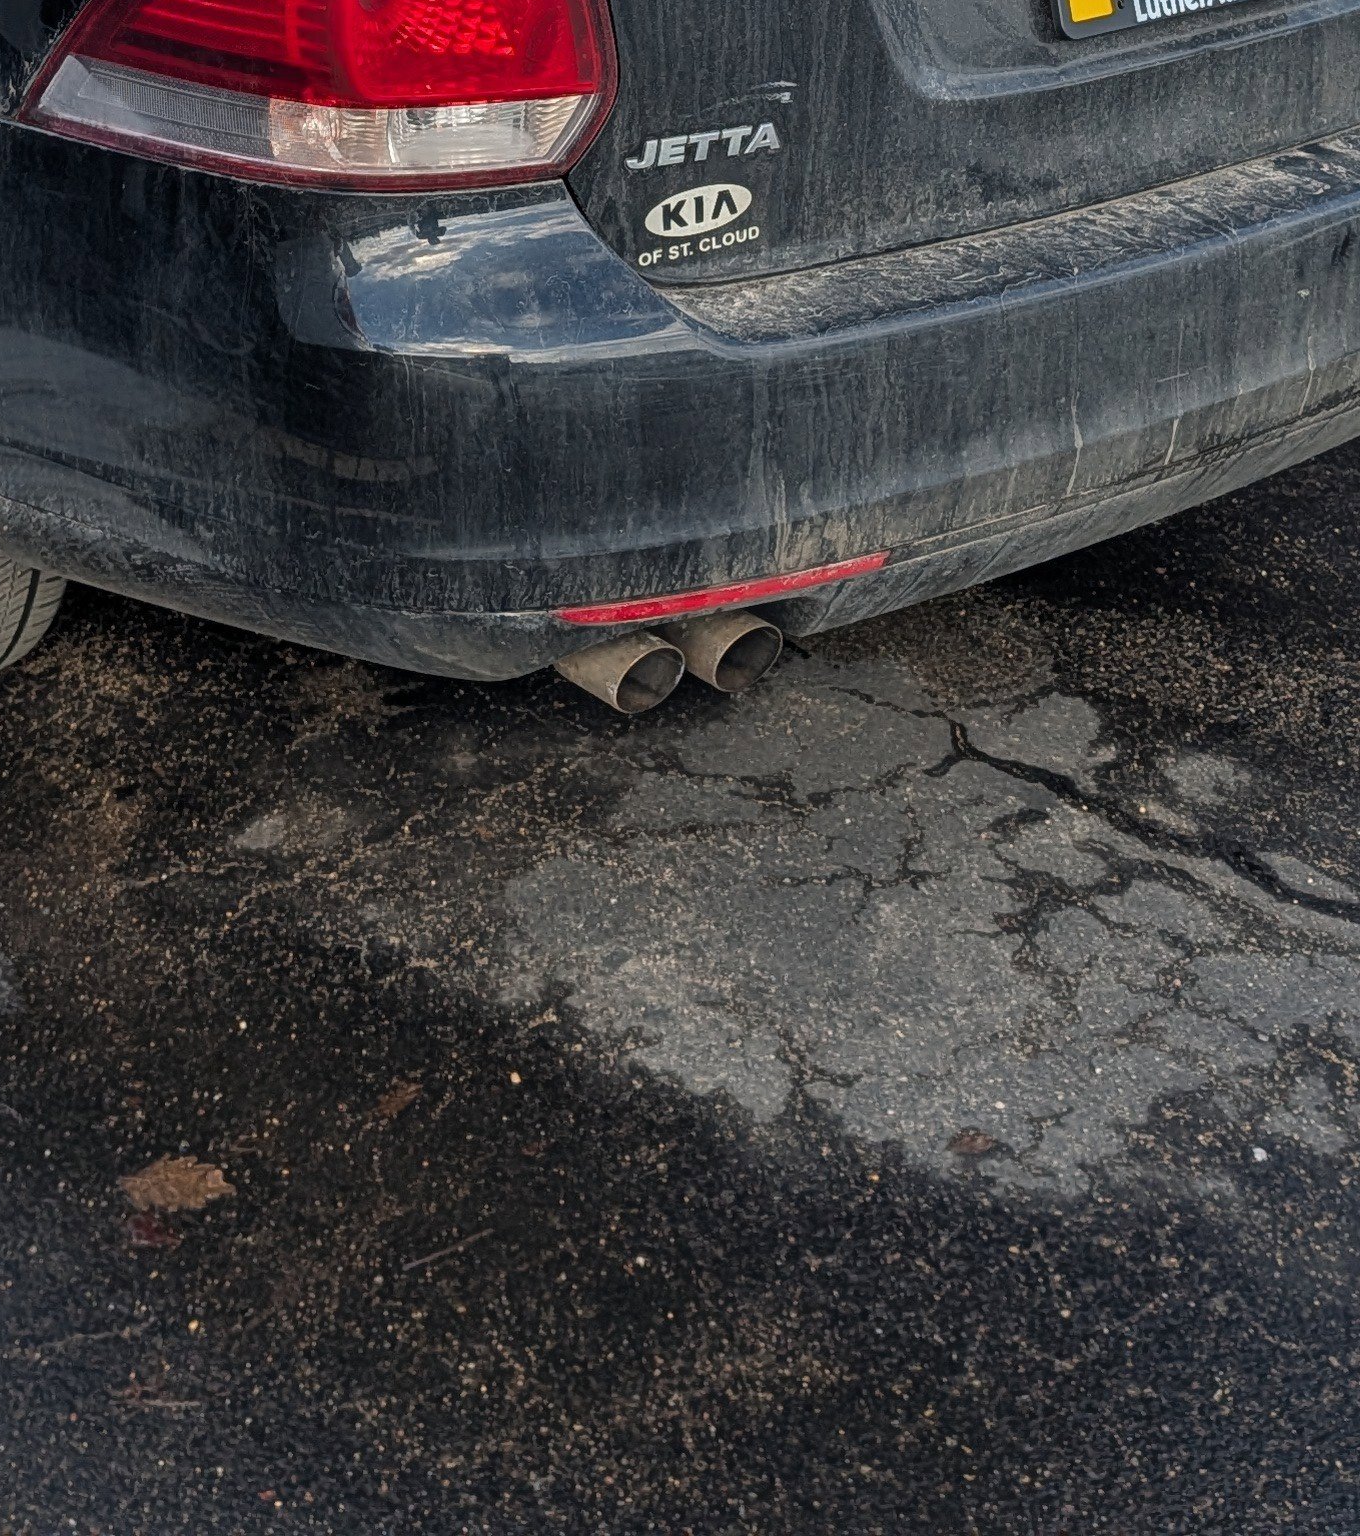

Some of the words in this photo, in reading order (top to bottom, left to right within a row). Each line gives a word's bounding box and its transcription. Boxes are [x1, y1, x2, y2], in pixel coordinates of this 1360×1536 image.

[625, 122, 781, 170] JETTA
[660, 188, 739, 232] KIA
[638, 248, 663, 266] OF
[668, 242, 694, 261] ST.
[699, 225, 760, 253] CLOUD
